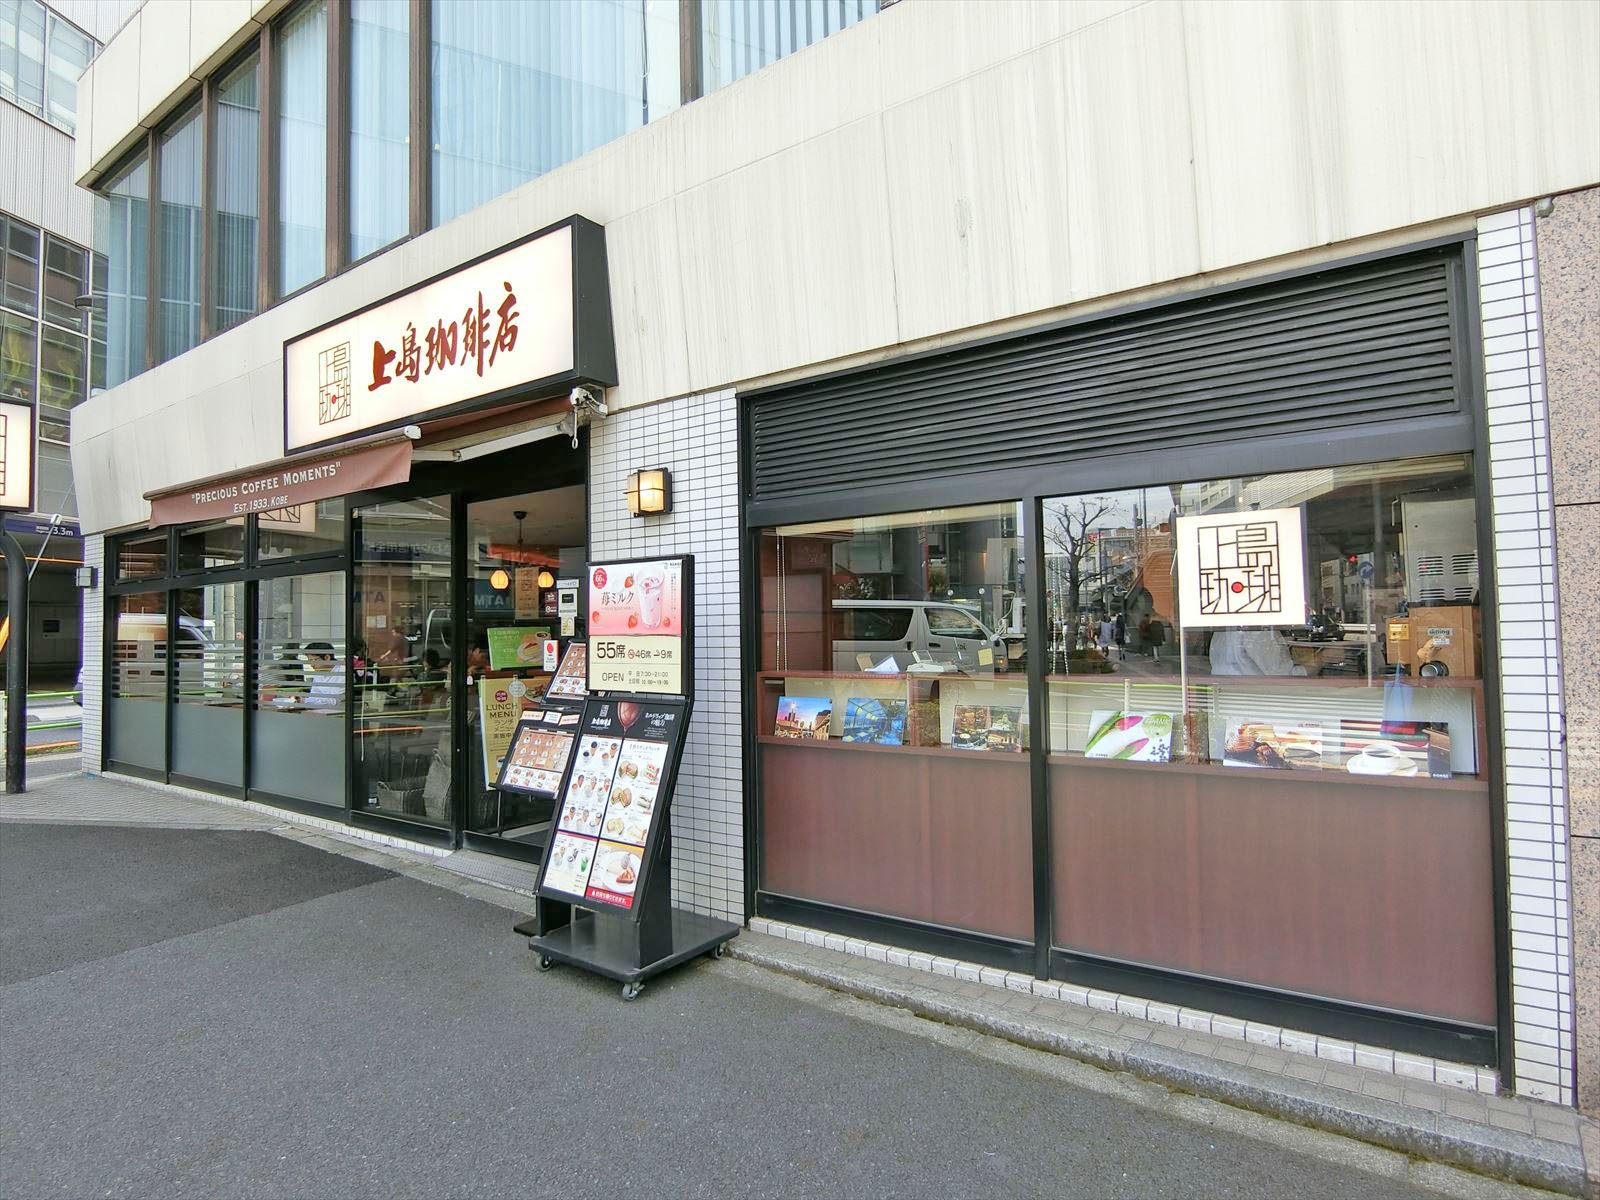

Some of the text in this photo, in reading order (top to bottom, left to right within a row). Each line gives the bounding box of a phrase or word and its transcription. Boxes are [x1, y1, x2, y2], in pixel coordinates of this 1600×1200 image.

[367, 281, 520, 392] 上島珈琲店
[52, 527, 74, 536] 3.3m
[602, 672, 624, 681] OPEN
[486, 703, 517, 711] LUNCH
